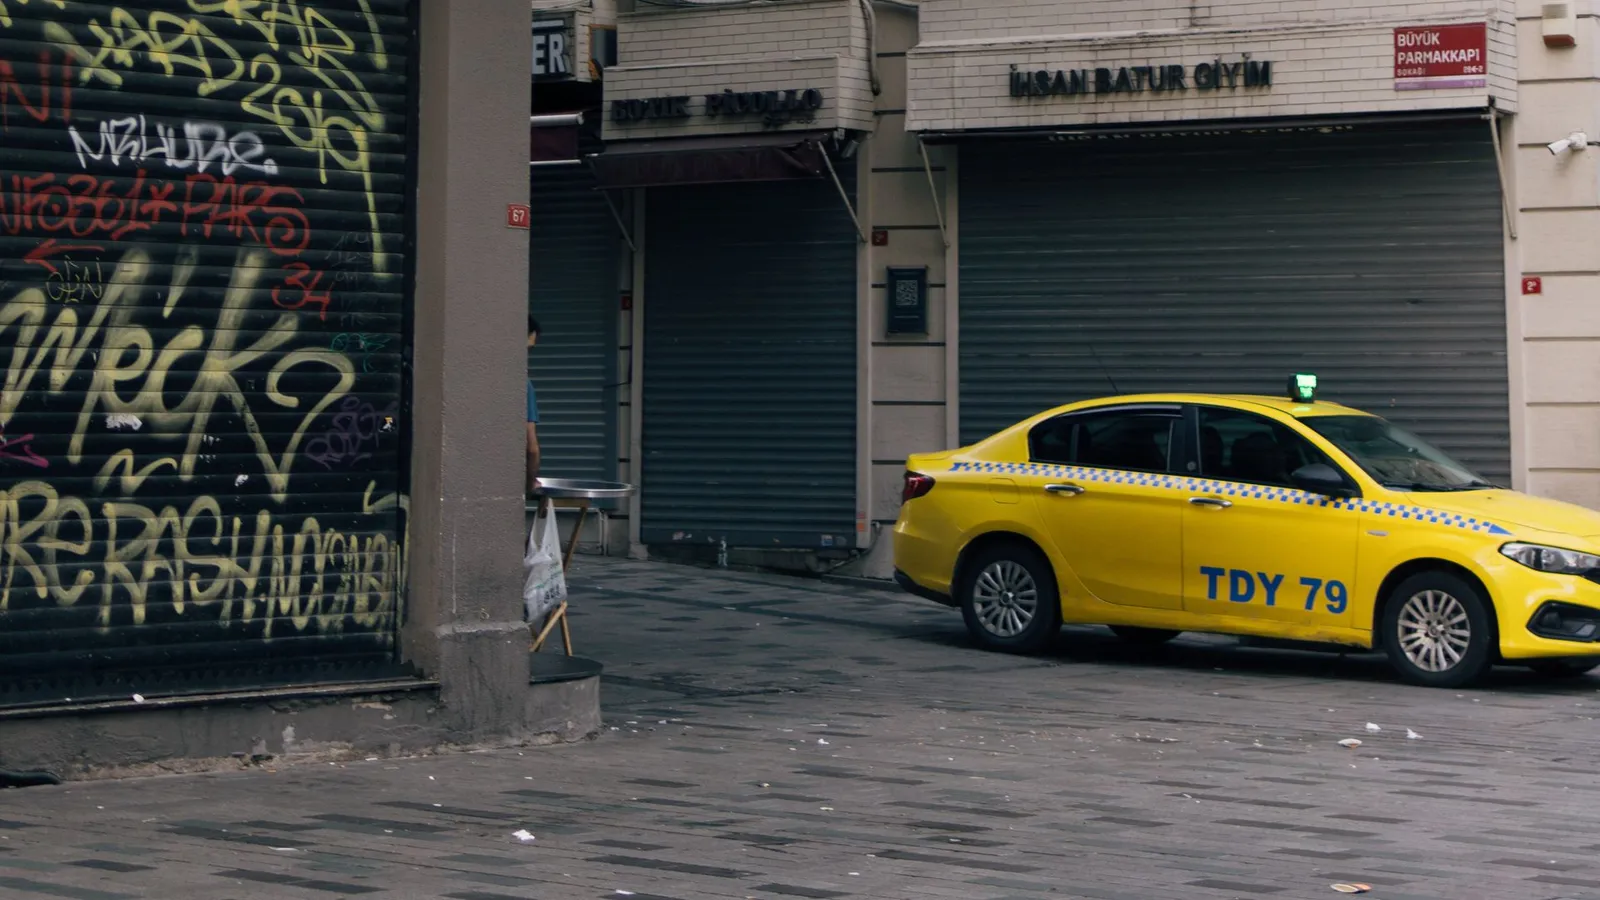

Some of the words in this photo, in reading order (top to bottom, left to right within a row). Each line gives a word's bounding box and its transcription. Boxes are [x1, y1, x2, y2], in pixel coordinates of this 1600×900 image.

[1397, 31, 1440, 47] BÜYÜK
[1397, 48, 1480, 65] PARMAKKAPI
[1009, 64, 1087, 97] İHSAN
[1094, 64, 1187, 95] BATUR
[1194, 52, 1272, 91] GİYİM
[512, 209, 525, 223] 67
[1200, 565, 1285, 606] TDY
[1300, 576, 1348, 614] 79
